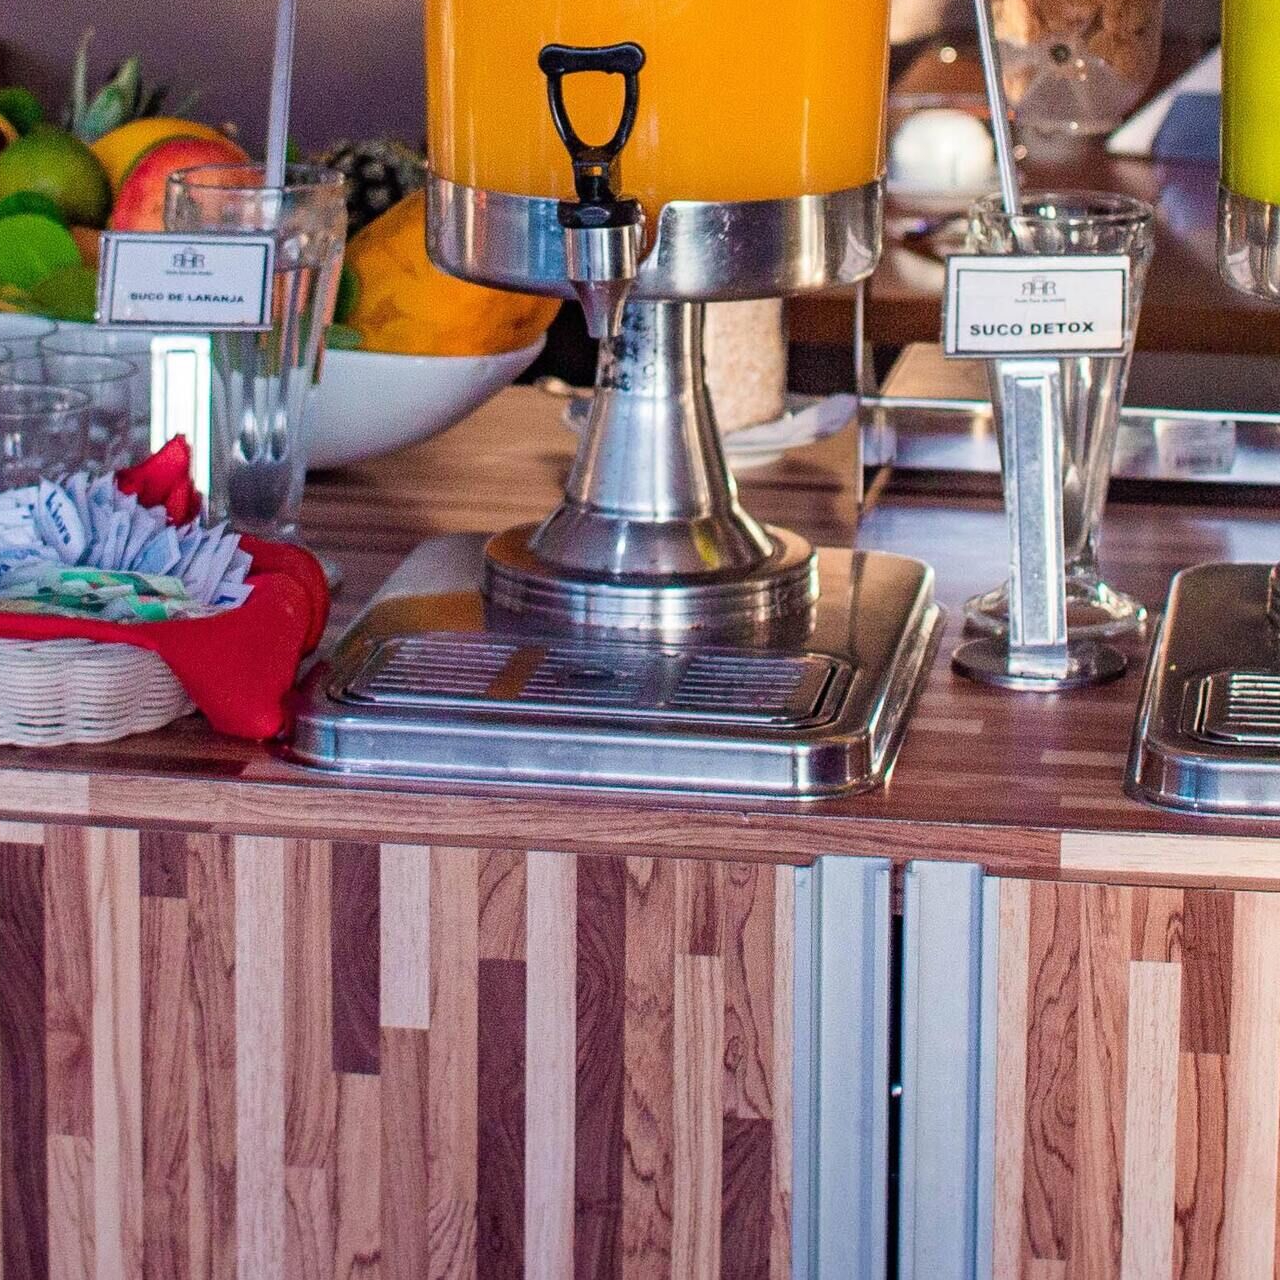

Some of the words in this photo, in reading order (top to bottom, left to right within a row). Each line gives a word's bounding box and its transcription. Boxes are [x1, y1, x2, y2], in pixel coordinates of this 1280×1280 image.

[168, 292, 184, 302] DE
[969, 322, 1023, 337] SUCO
[1030, 320, 1095, 336] DETOX
